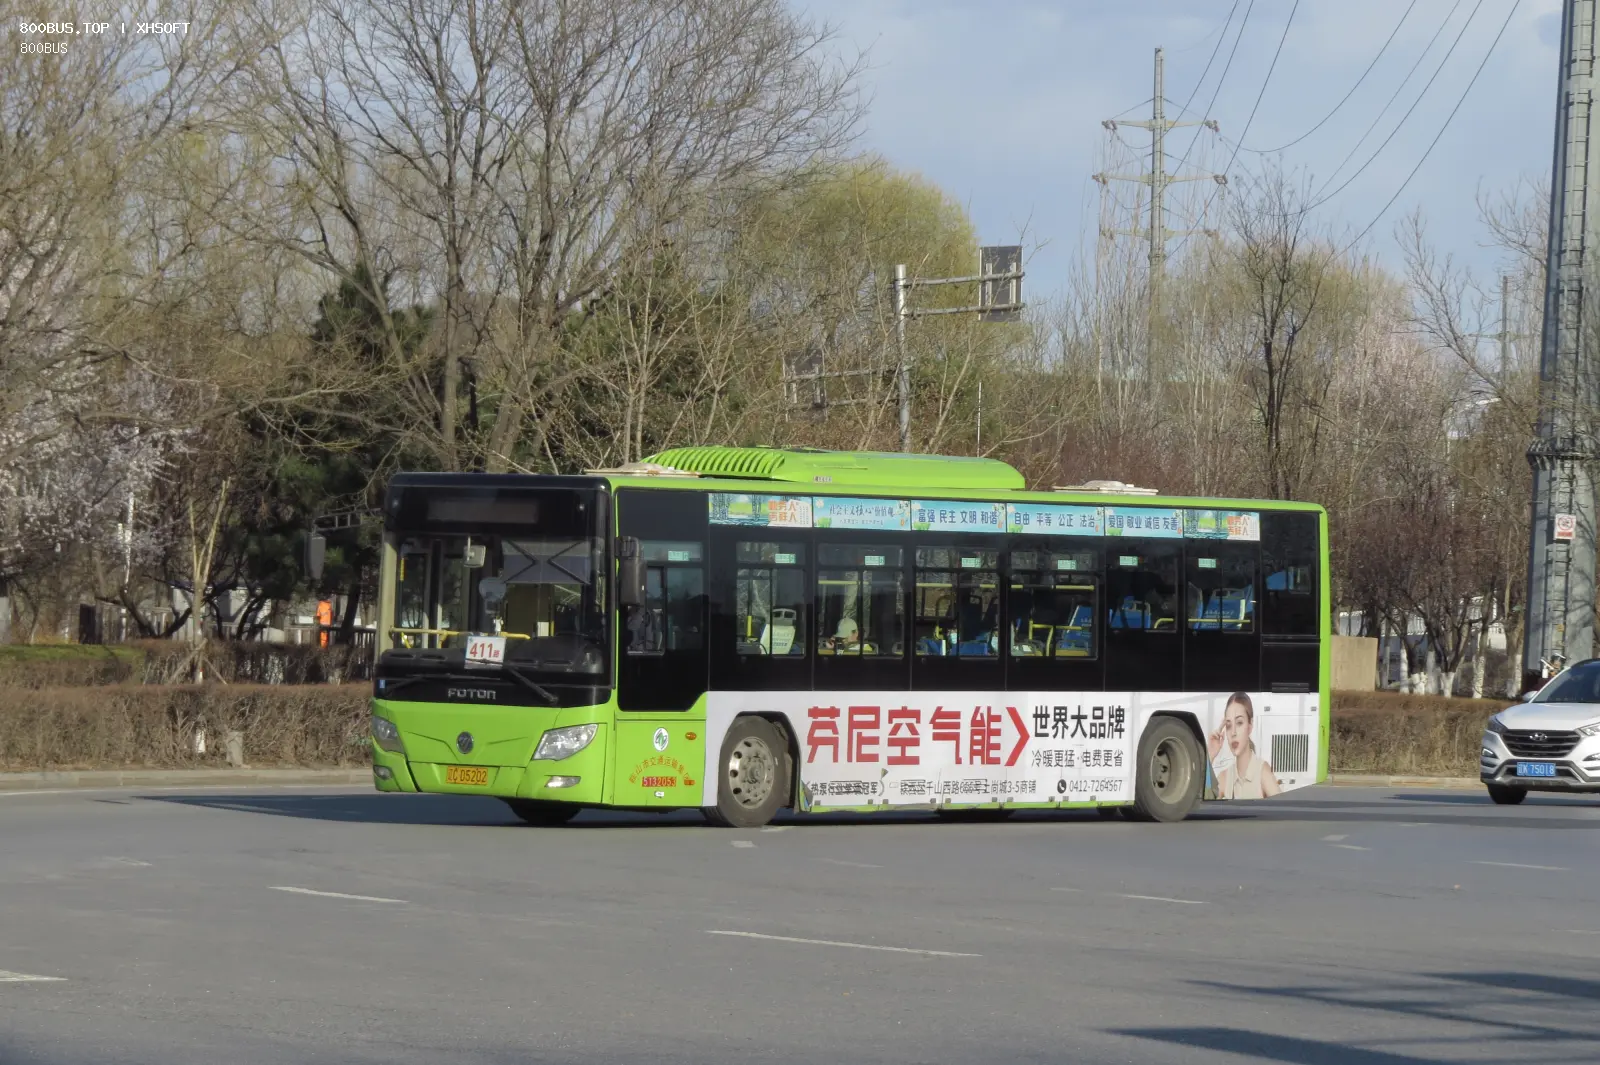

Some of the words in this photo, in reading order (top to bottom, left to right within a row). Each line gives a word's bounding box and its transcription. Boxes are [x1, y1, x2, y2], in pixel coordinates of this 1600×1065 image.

[918, 508, 936, 523] 富强
[939, 509, 957, 524] 民主
[960, 510, 977, 524] 文明
[980, 511, 998, 525] 和谐
[1014, 512, 1030, 525] 自由
[1036, 513, 1052, 526] 平等
[1058, 513, 1074, 527] 公正
[1079, 514, 1095, 528] 法治
[1108, 515, 1124, 529] 爱国
[1126, 515, 1142, 529] 敬业
[1144, 516, 1160, 530] 诚信
[1162, 516, 1178, 530] 友善
[447, 687, 496, 700] FOTON
[1032, 705, 1126, 740] 世界大品牌
[807, 705, 1002, 765] 芬尼空气能
[643, 777, 676, 787] 5132053
[1069, 779, 1123, 793] 0412-7264567
